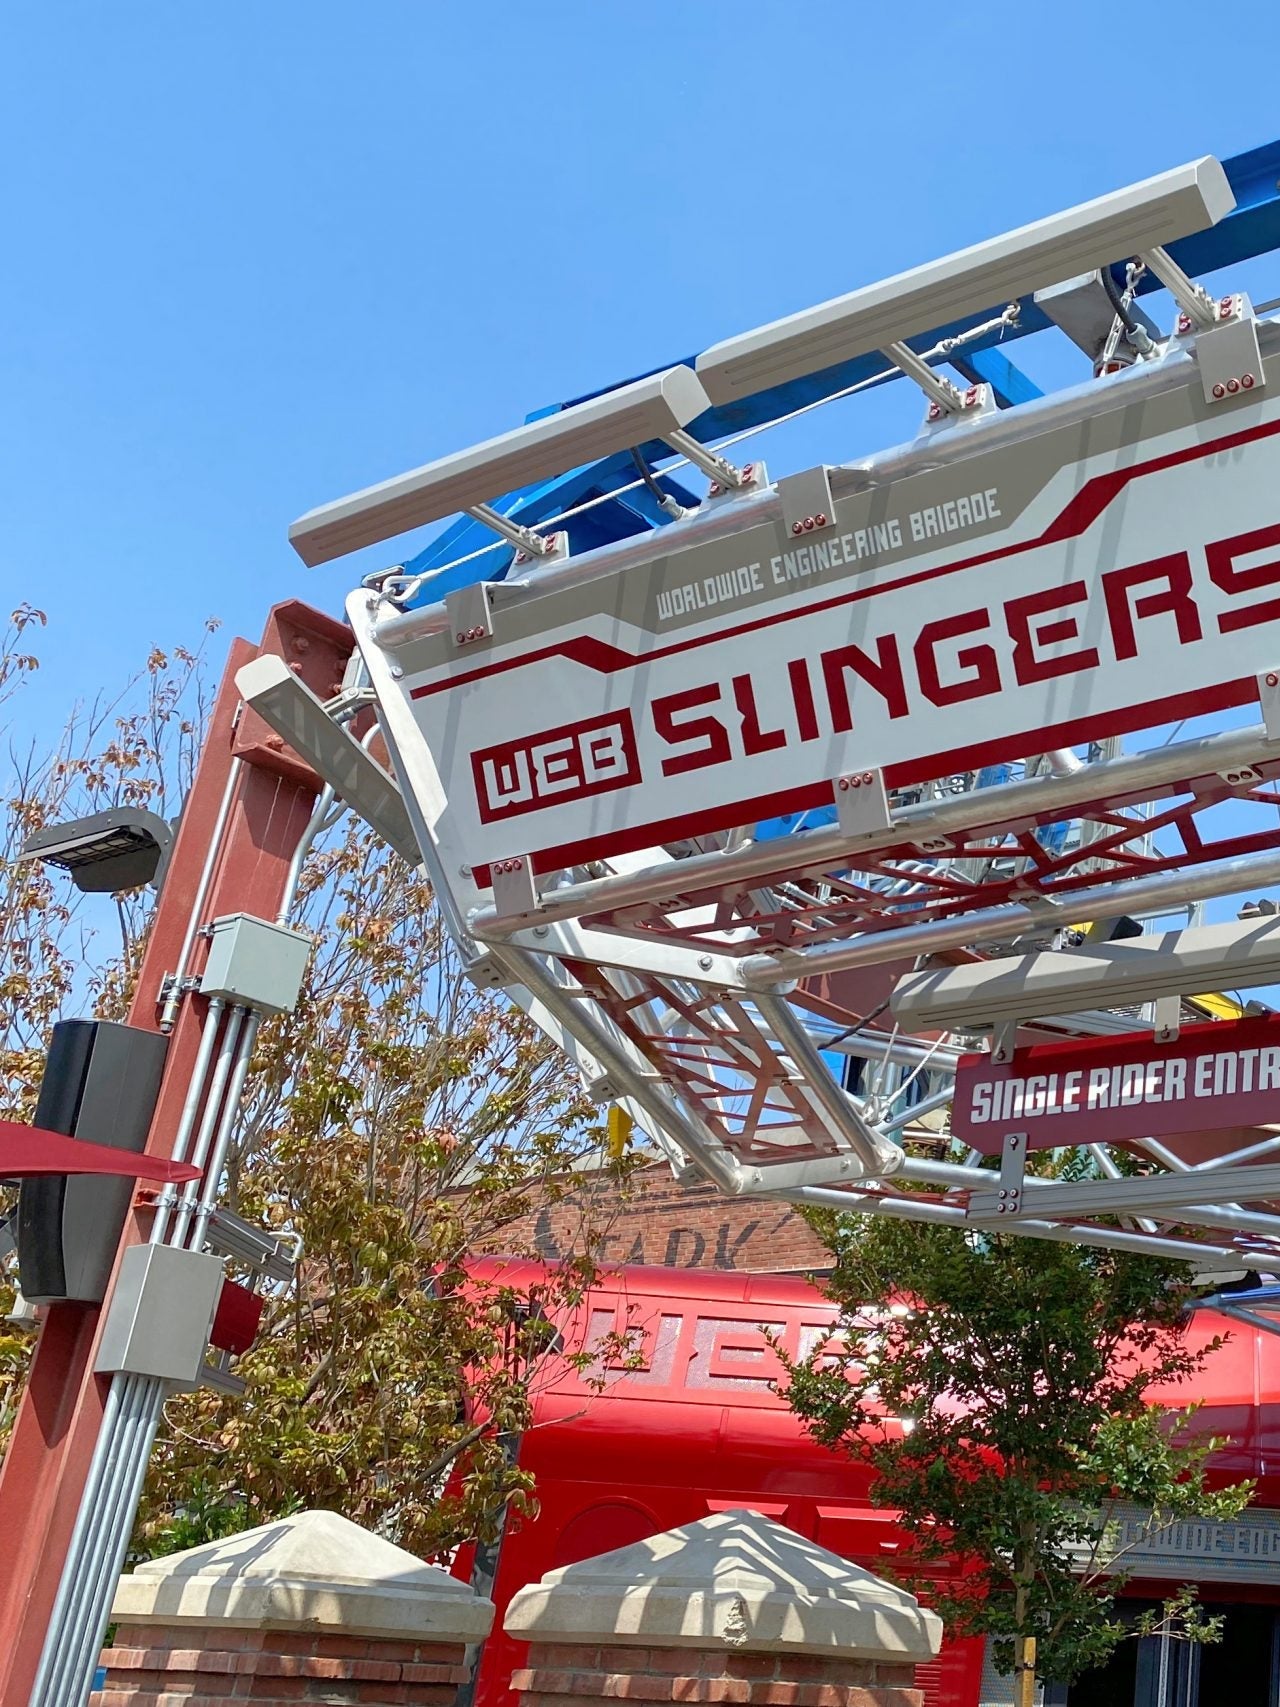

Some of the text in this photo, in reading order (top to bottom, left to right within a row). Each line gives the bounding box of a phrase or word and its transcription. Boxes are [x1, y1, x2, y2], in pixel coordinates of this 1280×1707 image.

[656, 487, 1002, 621] WORLDWIDE ENGINEERING BRIGADE
[481, 719, 629, 812] WEB
[970, 1070, 1083, 1124] SINGLE
[1087, 1058, 1187, 1110] RIDER
